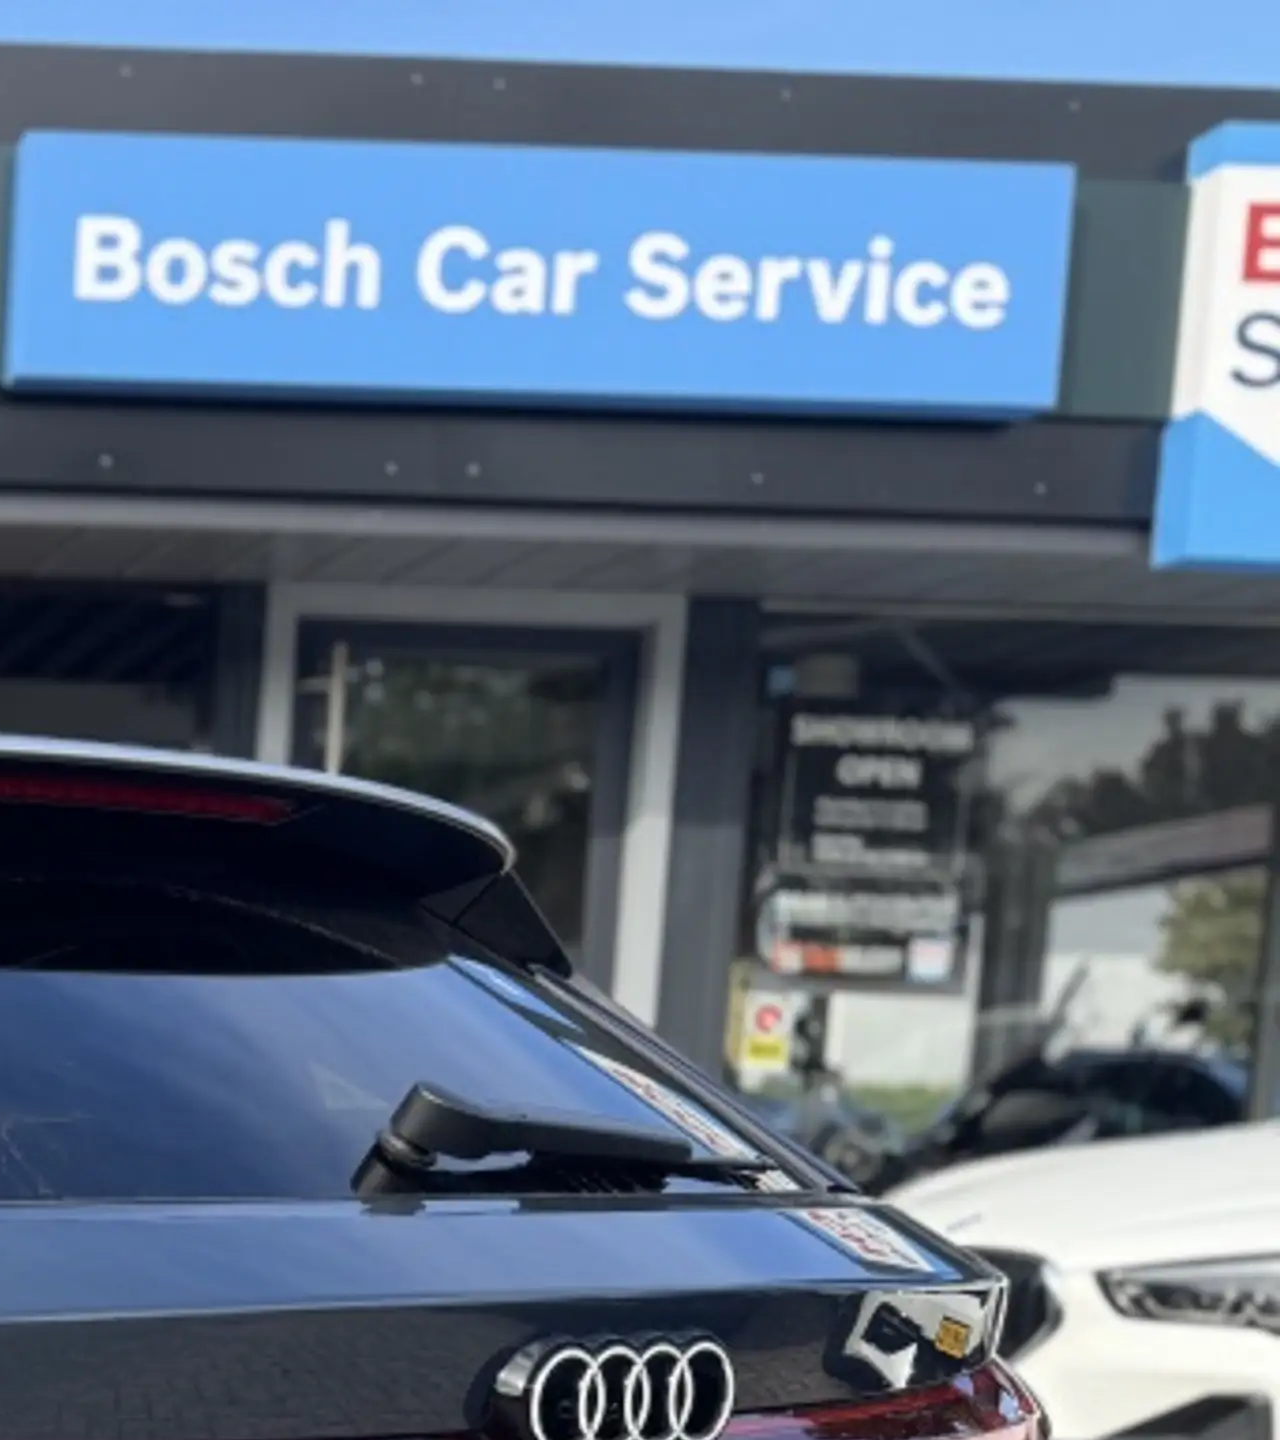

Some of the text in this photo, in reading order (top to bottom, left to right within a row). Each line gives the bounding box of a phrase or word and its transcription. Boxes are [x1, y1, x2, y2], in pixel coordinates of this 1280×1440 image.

[71, 213, 1011, 329] Bosch Car Service
[836, 753, 923, 789] OPEN
